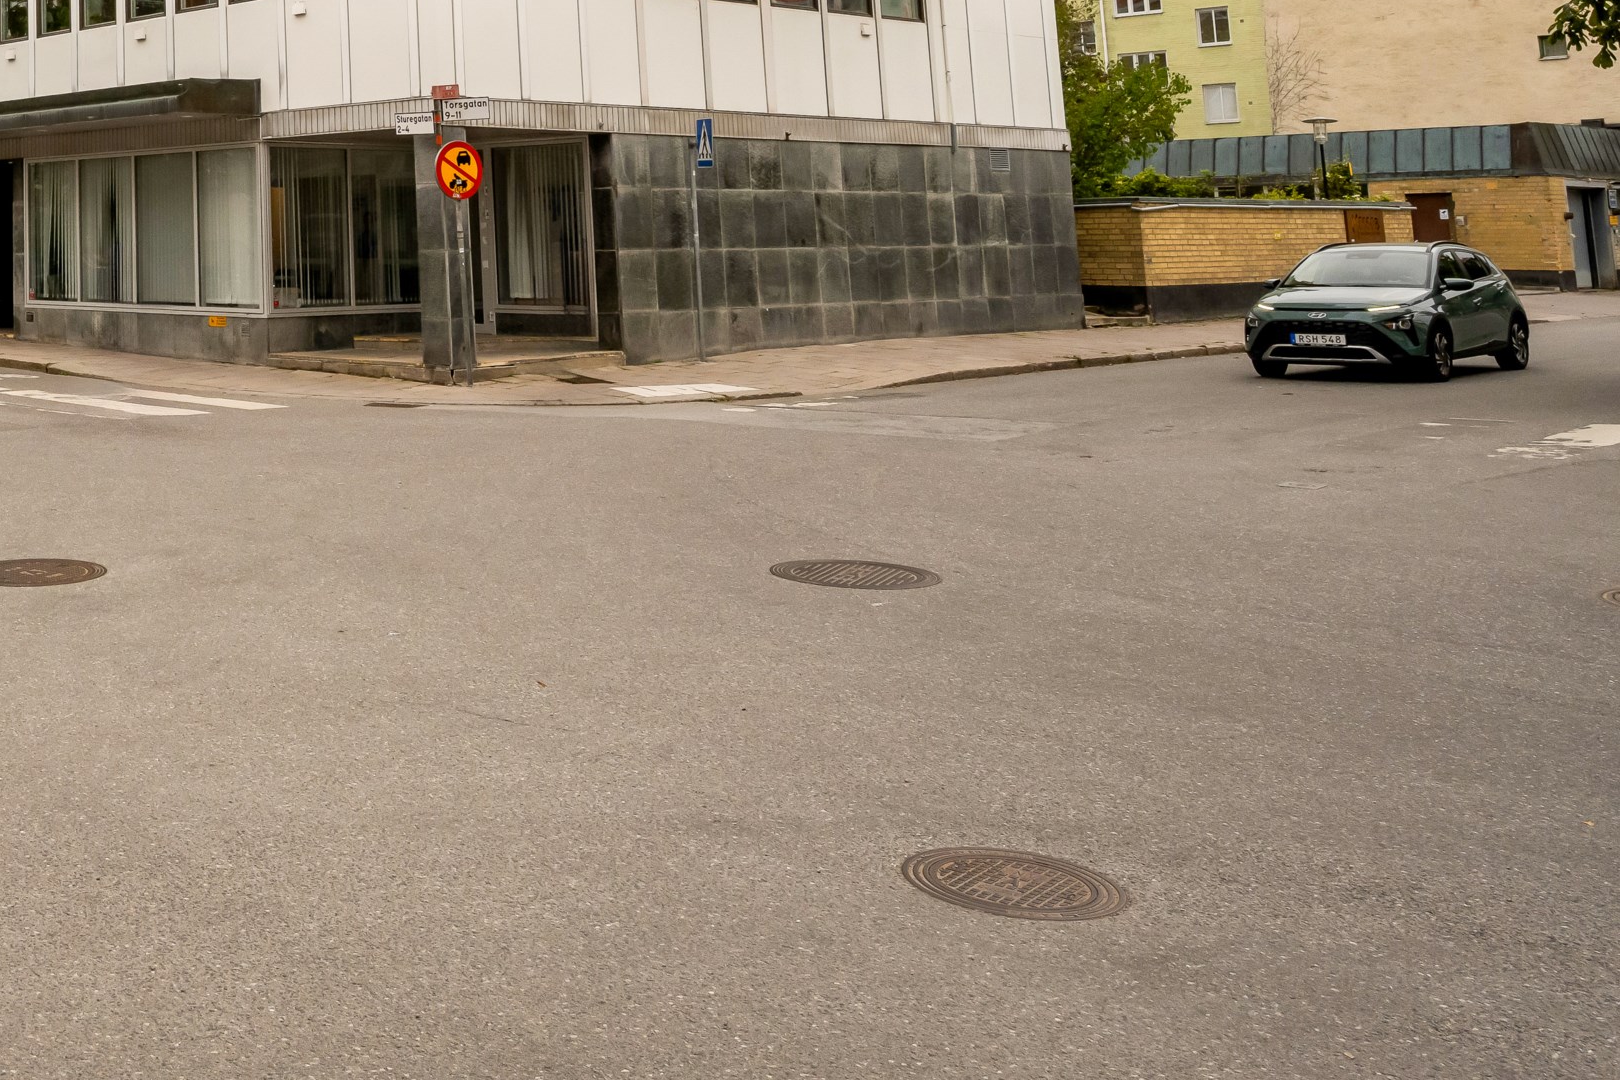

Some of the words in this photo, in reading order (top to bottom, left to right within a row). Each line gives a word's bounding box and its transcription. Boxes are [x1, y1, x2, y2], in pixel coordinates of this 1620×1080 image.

[444, 100, 487, 110] Torsgatan
[396, 114, 432, 124] Sturegatan
[445, 111, 462, 119] 9-11
[397, 125, 410, 133] 2-4
[1298, 335, 1318, 343] RSH
[1321, 335, 1342, 344] 548
